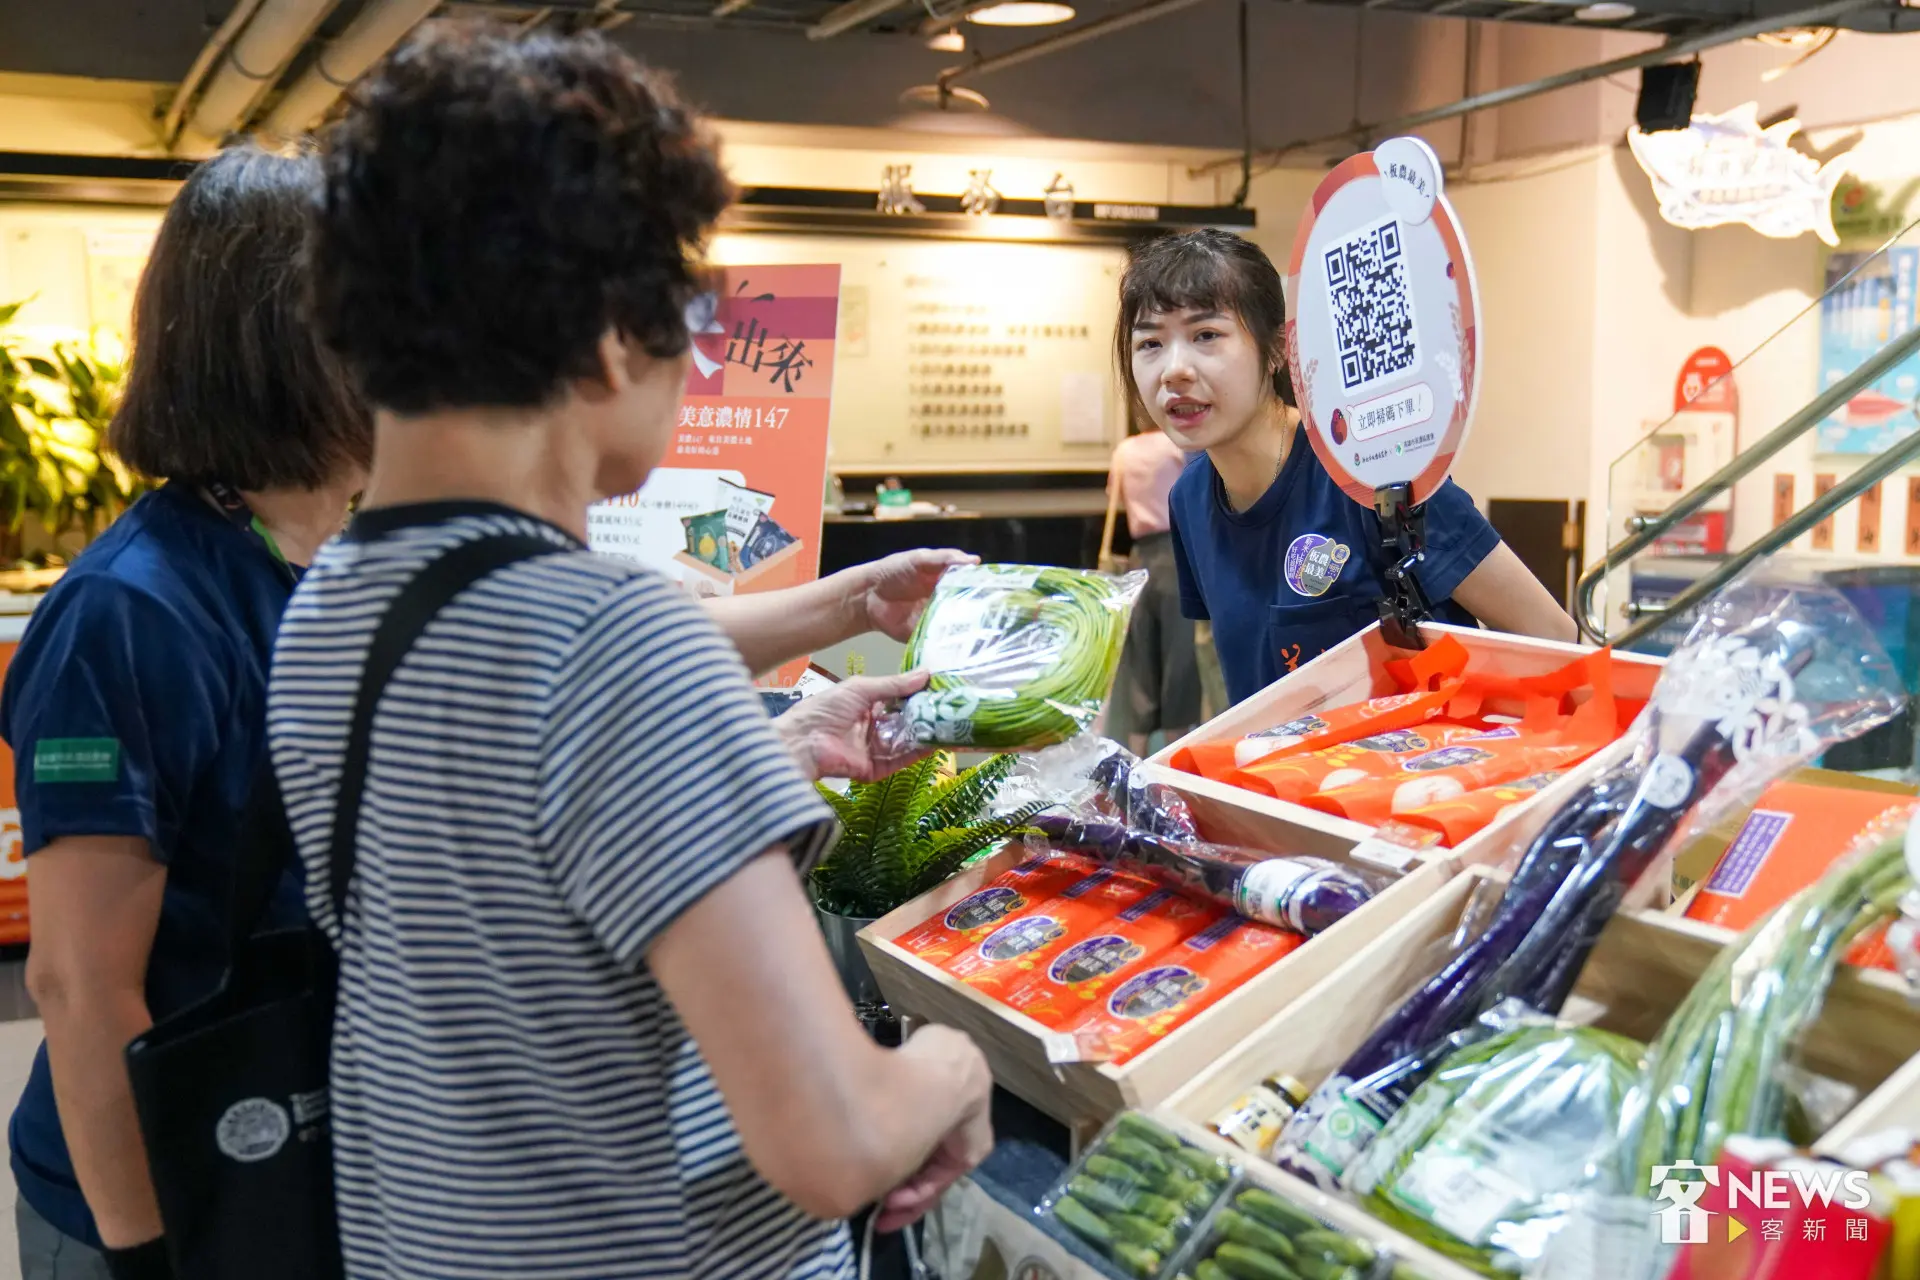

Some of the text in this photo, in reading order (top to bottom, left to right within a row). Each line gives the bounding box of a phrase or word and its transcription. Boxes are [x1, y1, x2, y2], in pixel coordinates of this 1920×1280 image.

[1389, 163, 1426, 196] 板農最美
[678, 405, 790, 430] 美意濃情147
[1309, 550, 1330, 567] 板農
